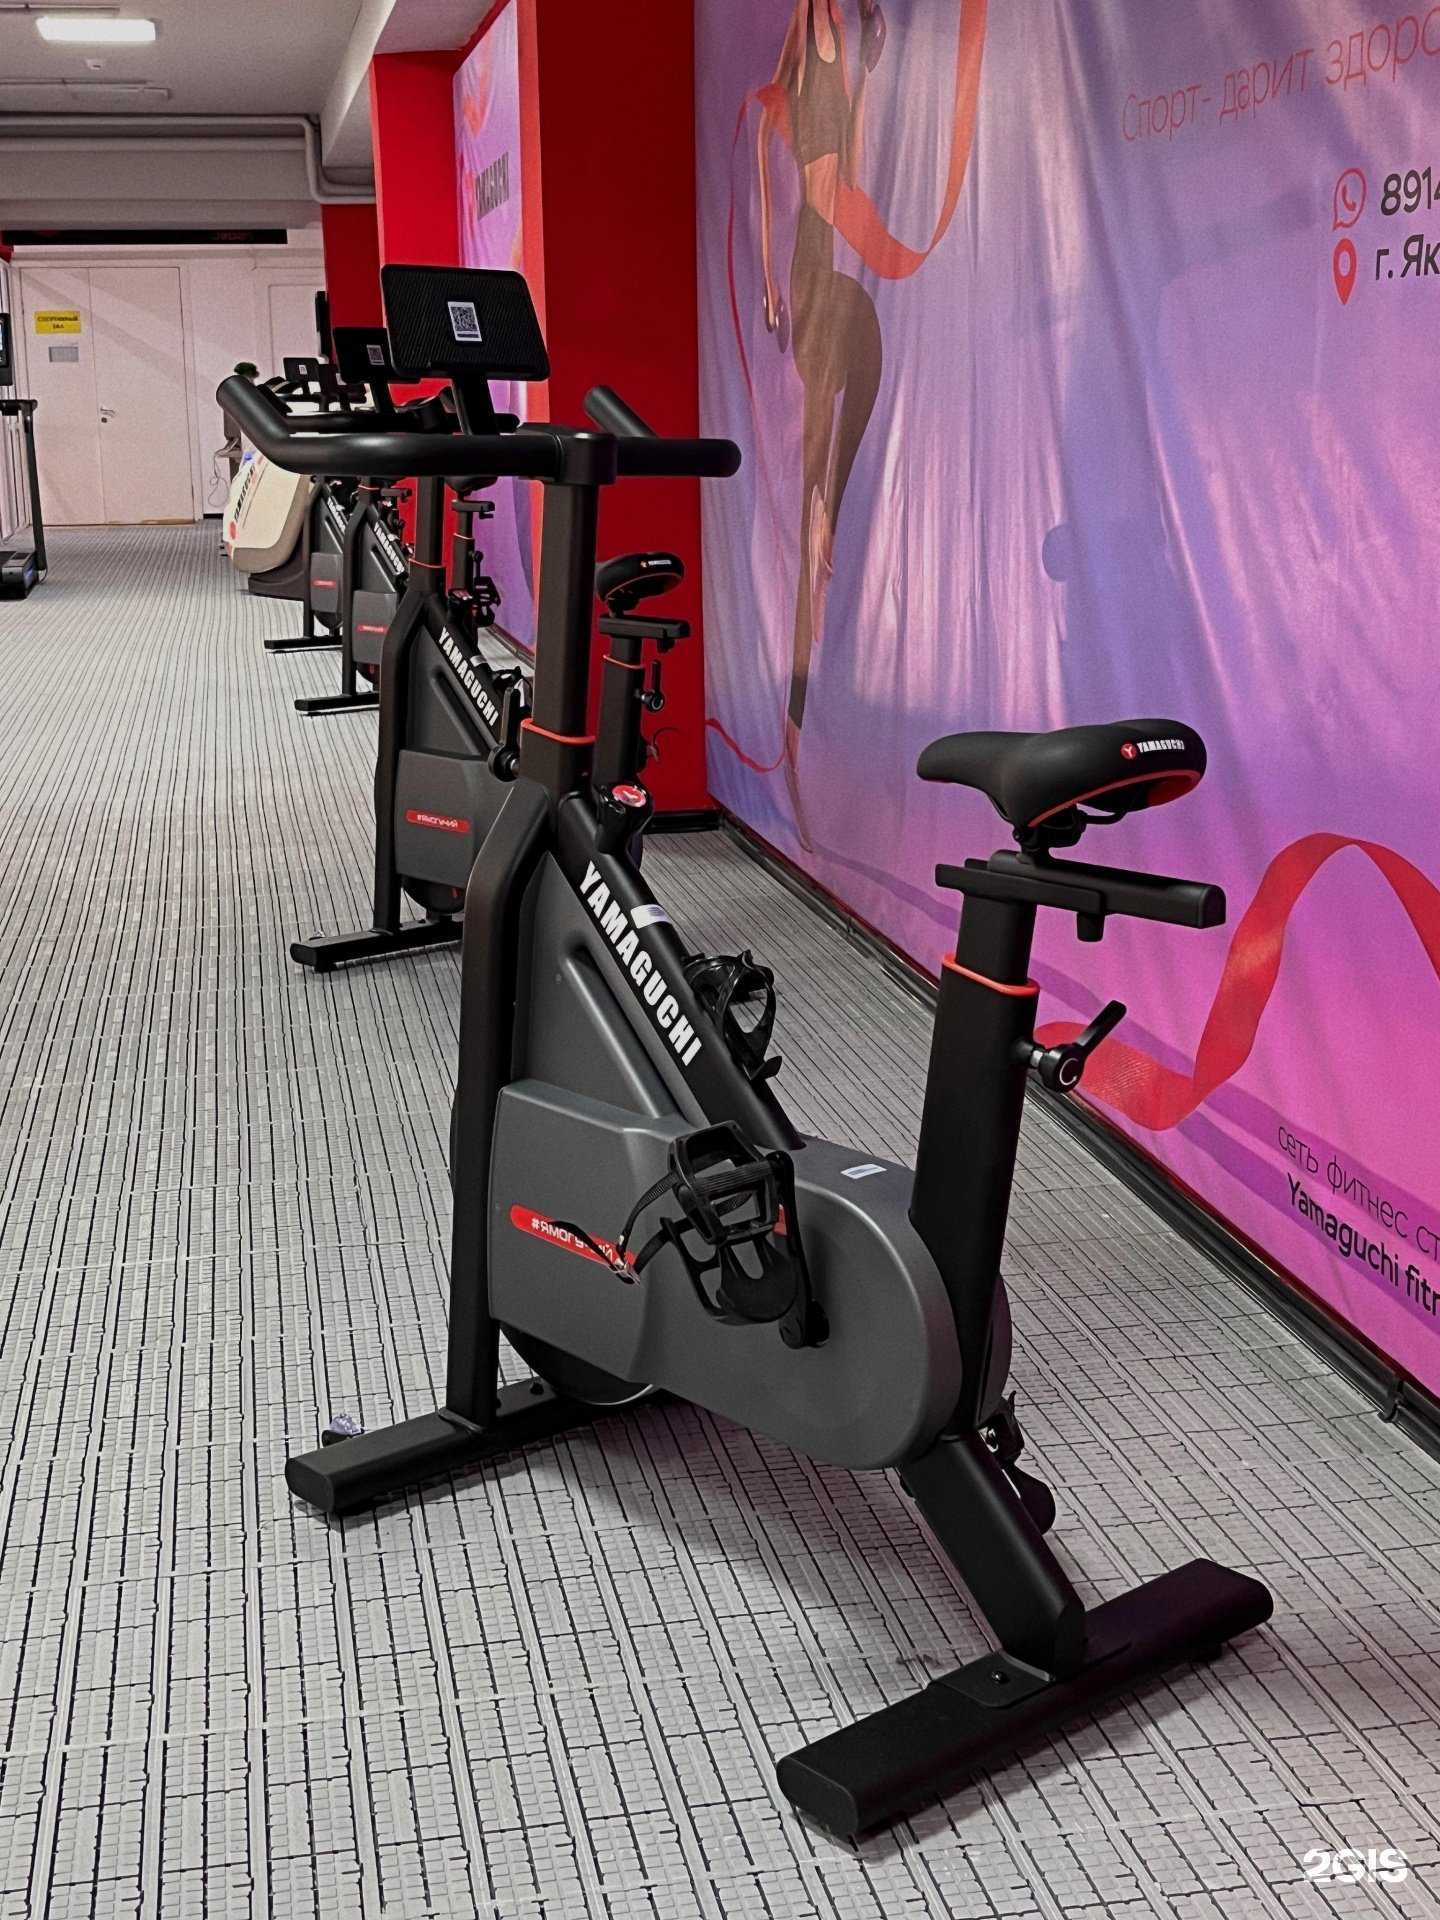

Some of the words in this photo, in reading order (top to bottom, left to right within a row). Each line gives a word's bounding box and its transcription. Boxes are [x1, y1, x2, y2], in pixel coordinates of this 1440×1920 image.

[1219, 49, 1314, 125] дарит
[1375, 248, 1394, 281] г.
[1400, 234, 1440, 278] Як
[437, 626, 499, 727] YAMAGUCHI
[1136, 739, 1185, 753] YAMAGUCHI
[579, 860, 702, 1067] YAMAGUCHI
[1278, 1126, 1319, 1174] сеть
[1326, 1155, 1409, 1239] фитнес
[1287, 1172, 1400, 1288] Yamaguchi
